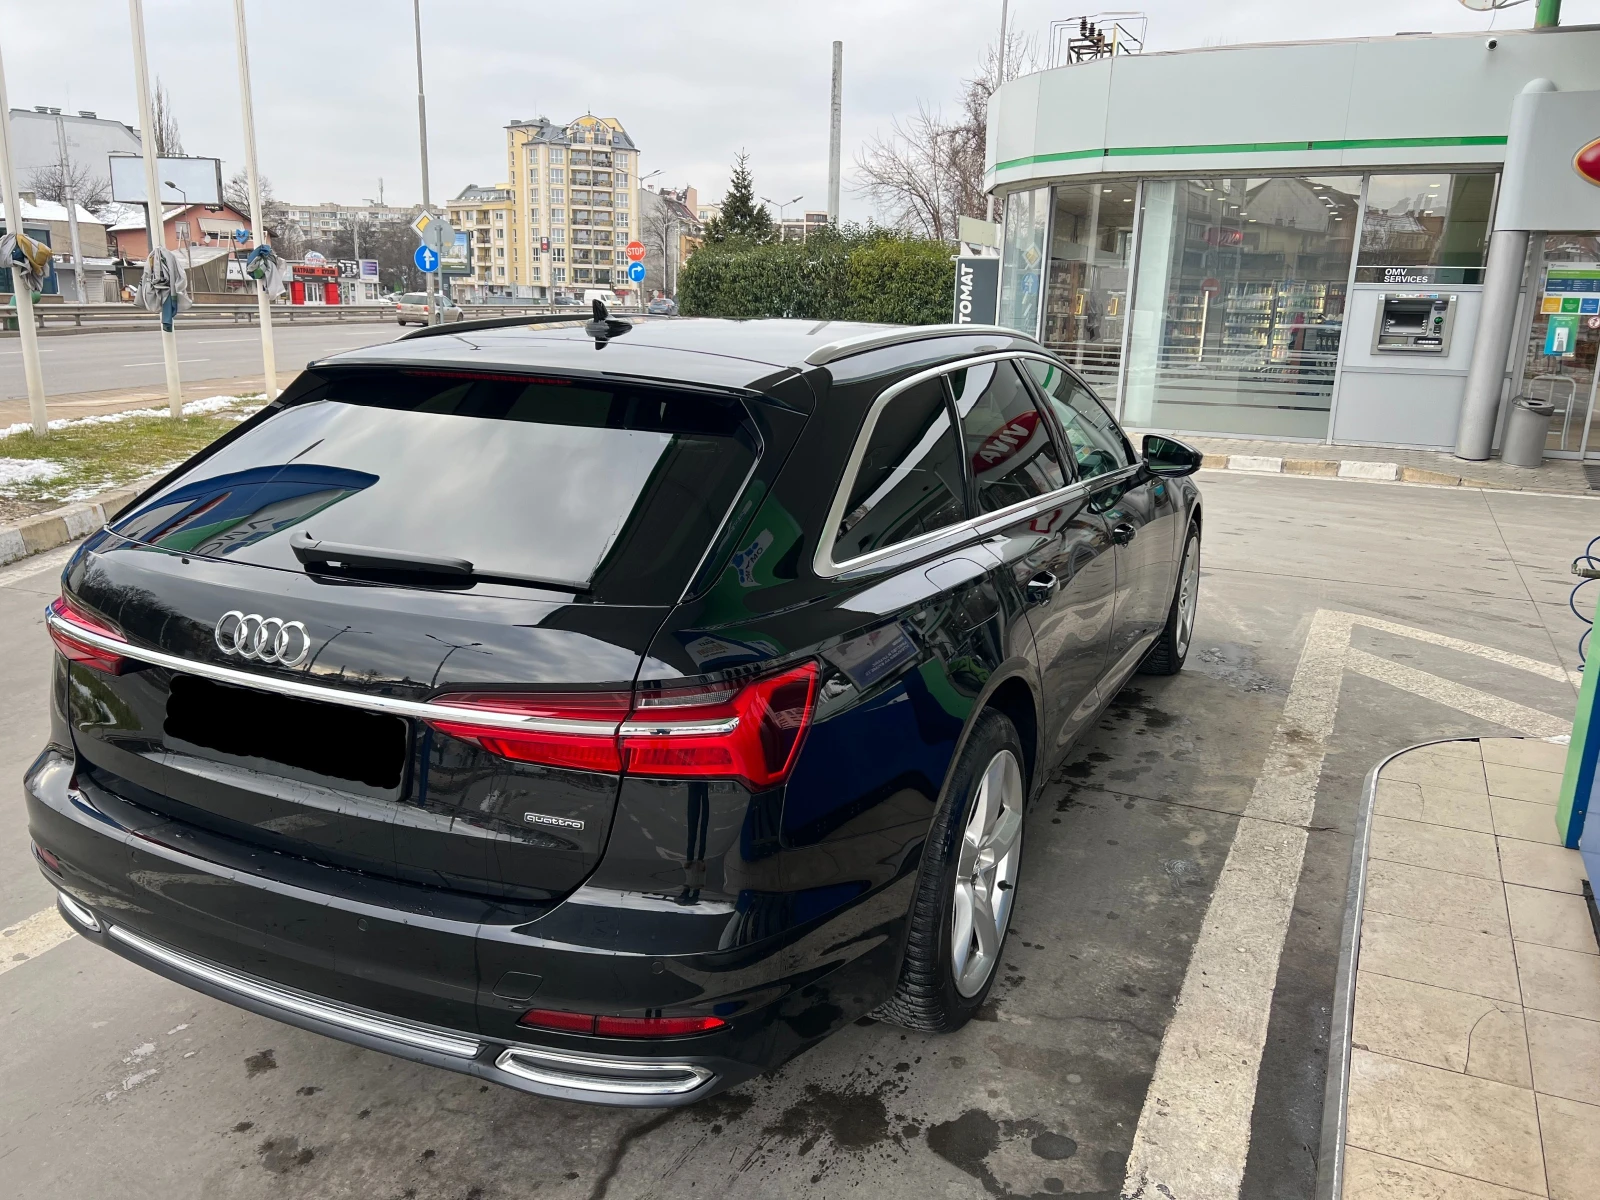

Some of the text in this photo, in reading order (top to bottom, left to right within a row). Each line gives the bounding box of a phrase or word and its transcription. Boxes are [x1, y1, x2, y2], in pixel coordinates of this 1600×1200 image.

[627, 247, 644, 256] STOP
[1383, 275, 1428, 283] SERVICES
[526, 815, 581, 828] quattro
